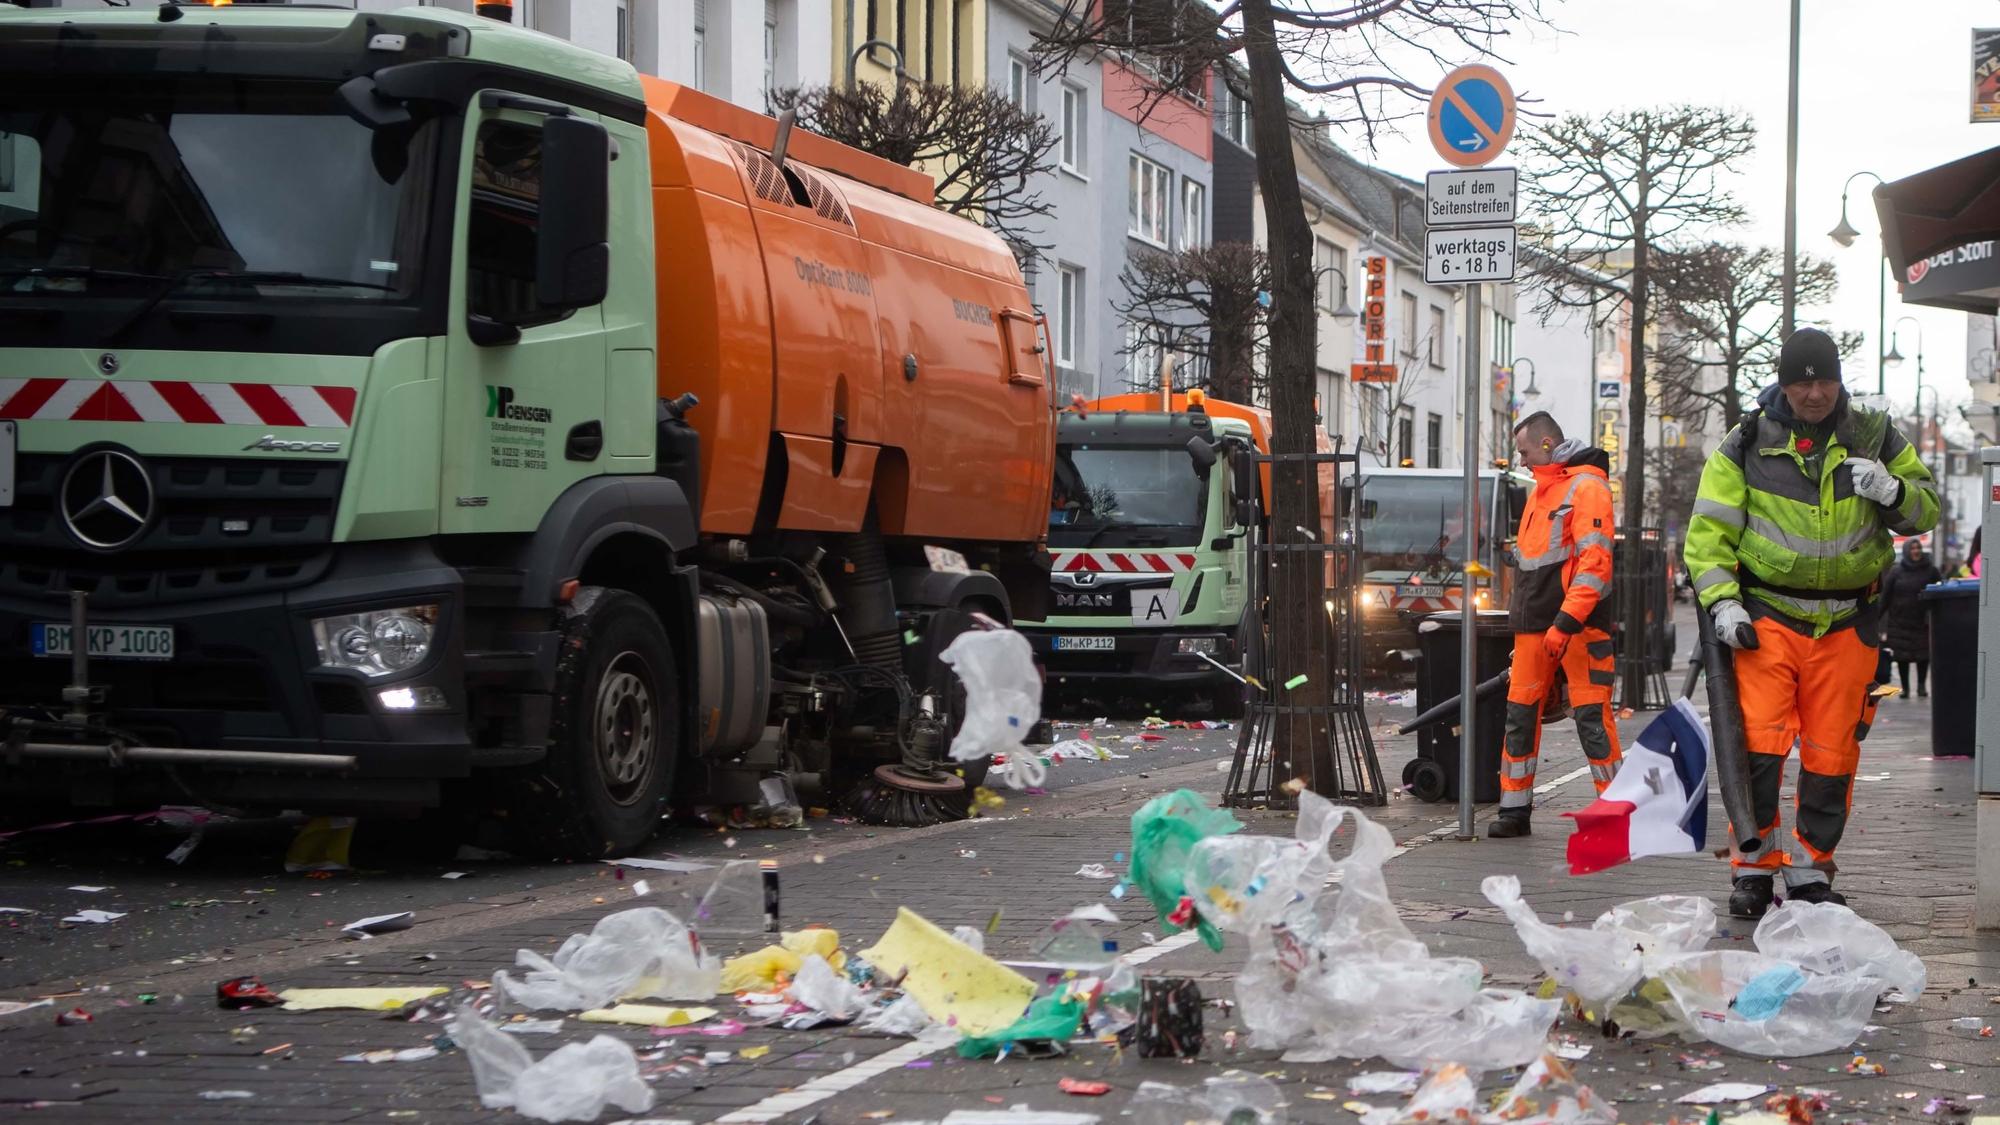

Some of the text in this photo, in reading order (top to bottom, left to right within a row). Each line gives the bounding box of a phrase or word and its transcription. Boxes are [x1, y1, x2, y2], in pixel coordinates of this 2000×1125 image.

[1447, 179, 1495, 196] auf dem
[1432, 198, 1510, 216] Seitenstreifen
[1435, 237, 1506, 257] werktags
[1441, 258, 1450, 275] 6
[1465, 257, 1483, 273] 18
[1488, 256, 1497, 273] h
[1056, 594, 1112, 607] MAN
[1145, 594, 1167, 621] A
[47, 626, 171, 654] BM KP 1008
[1094, 637, 1114, 648] 112
